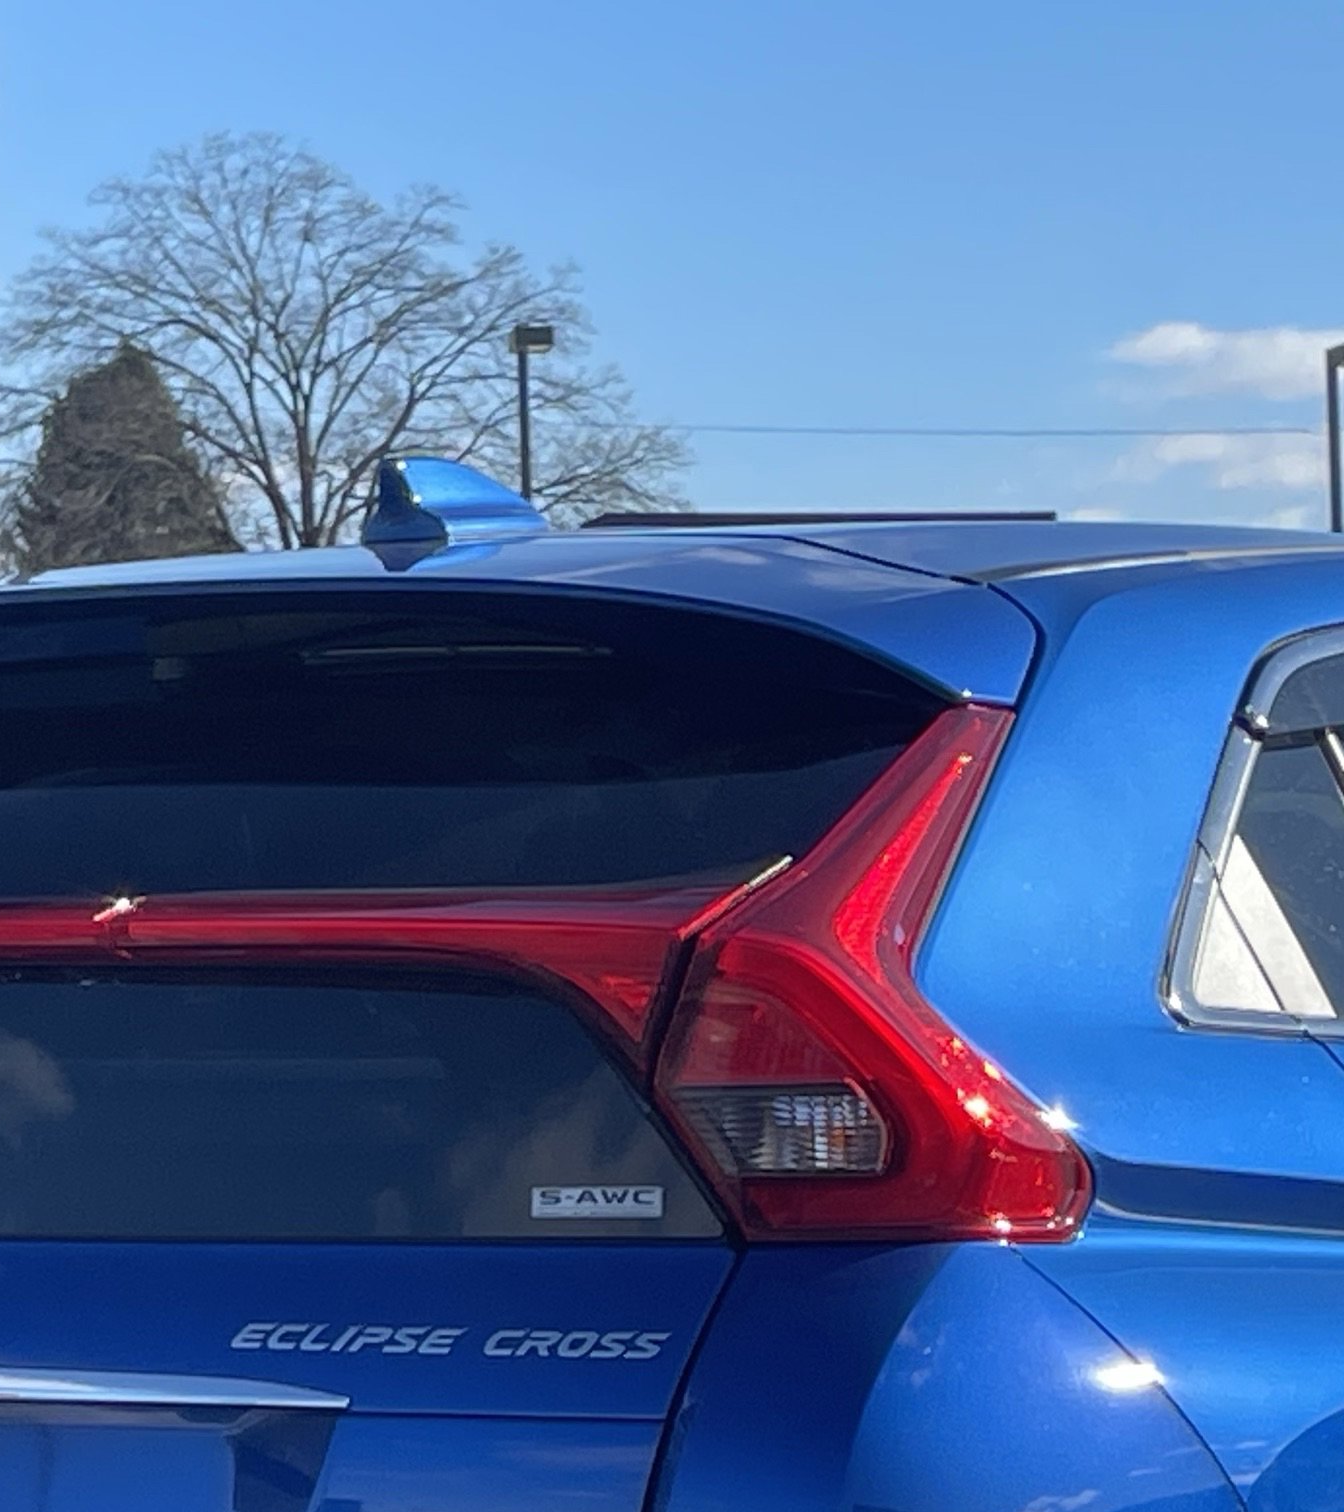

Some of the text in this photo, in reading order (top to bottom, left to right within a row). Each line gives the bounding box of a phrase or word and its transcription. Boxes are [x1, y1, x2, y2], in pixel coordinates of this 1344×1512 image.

[539, 1188, 656, 1206] S-AWC
[230, 1322, 672, 1360] ECLIPSE CROSS
